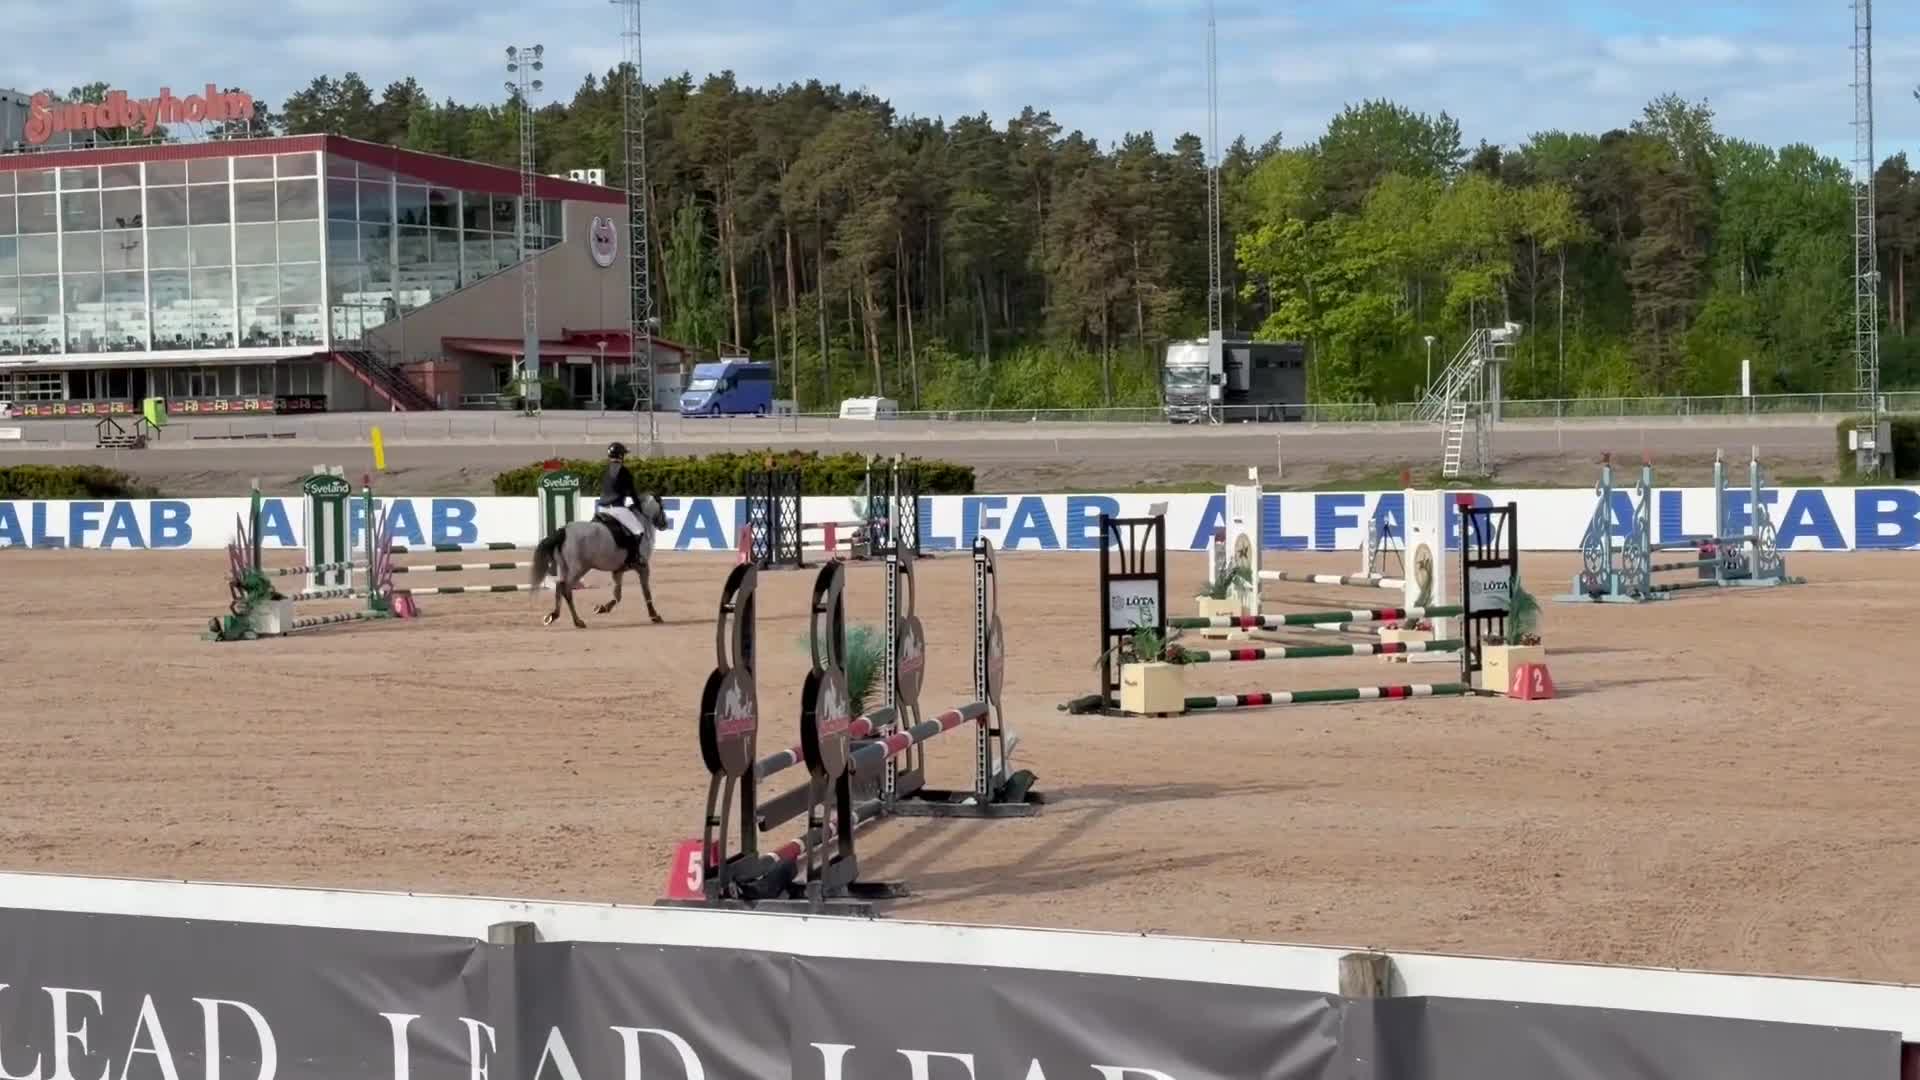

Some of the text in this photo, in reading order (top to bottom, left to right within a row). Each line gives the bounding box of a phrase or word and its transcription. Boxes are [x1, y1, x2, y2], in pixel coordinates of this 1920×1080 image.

[23, 84, 253, 145] Sundbyholm
[311, 482, 349, 494] Sveland
[543, 477, 579, 488] Sveland
[0, 500, 192, 549] ALFAB
[249, 498, 477, 547] AFAB
[1483, 580, 1508, 591] LÖTA
[1126, 595, 1155, 606] LÖTA
[1533, 667, 1544, 692] 2
[687, 851, 703, 892] 5
